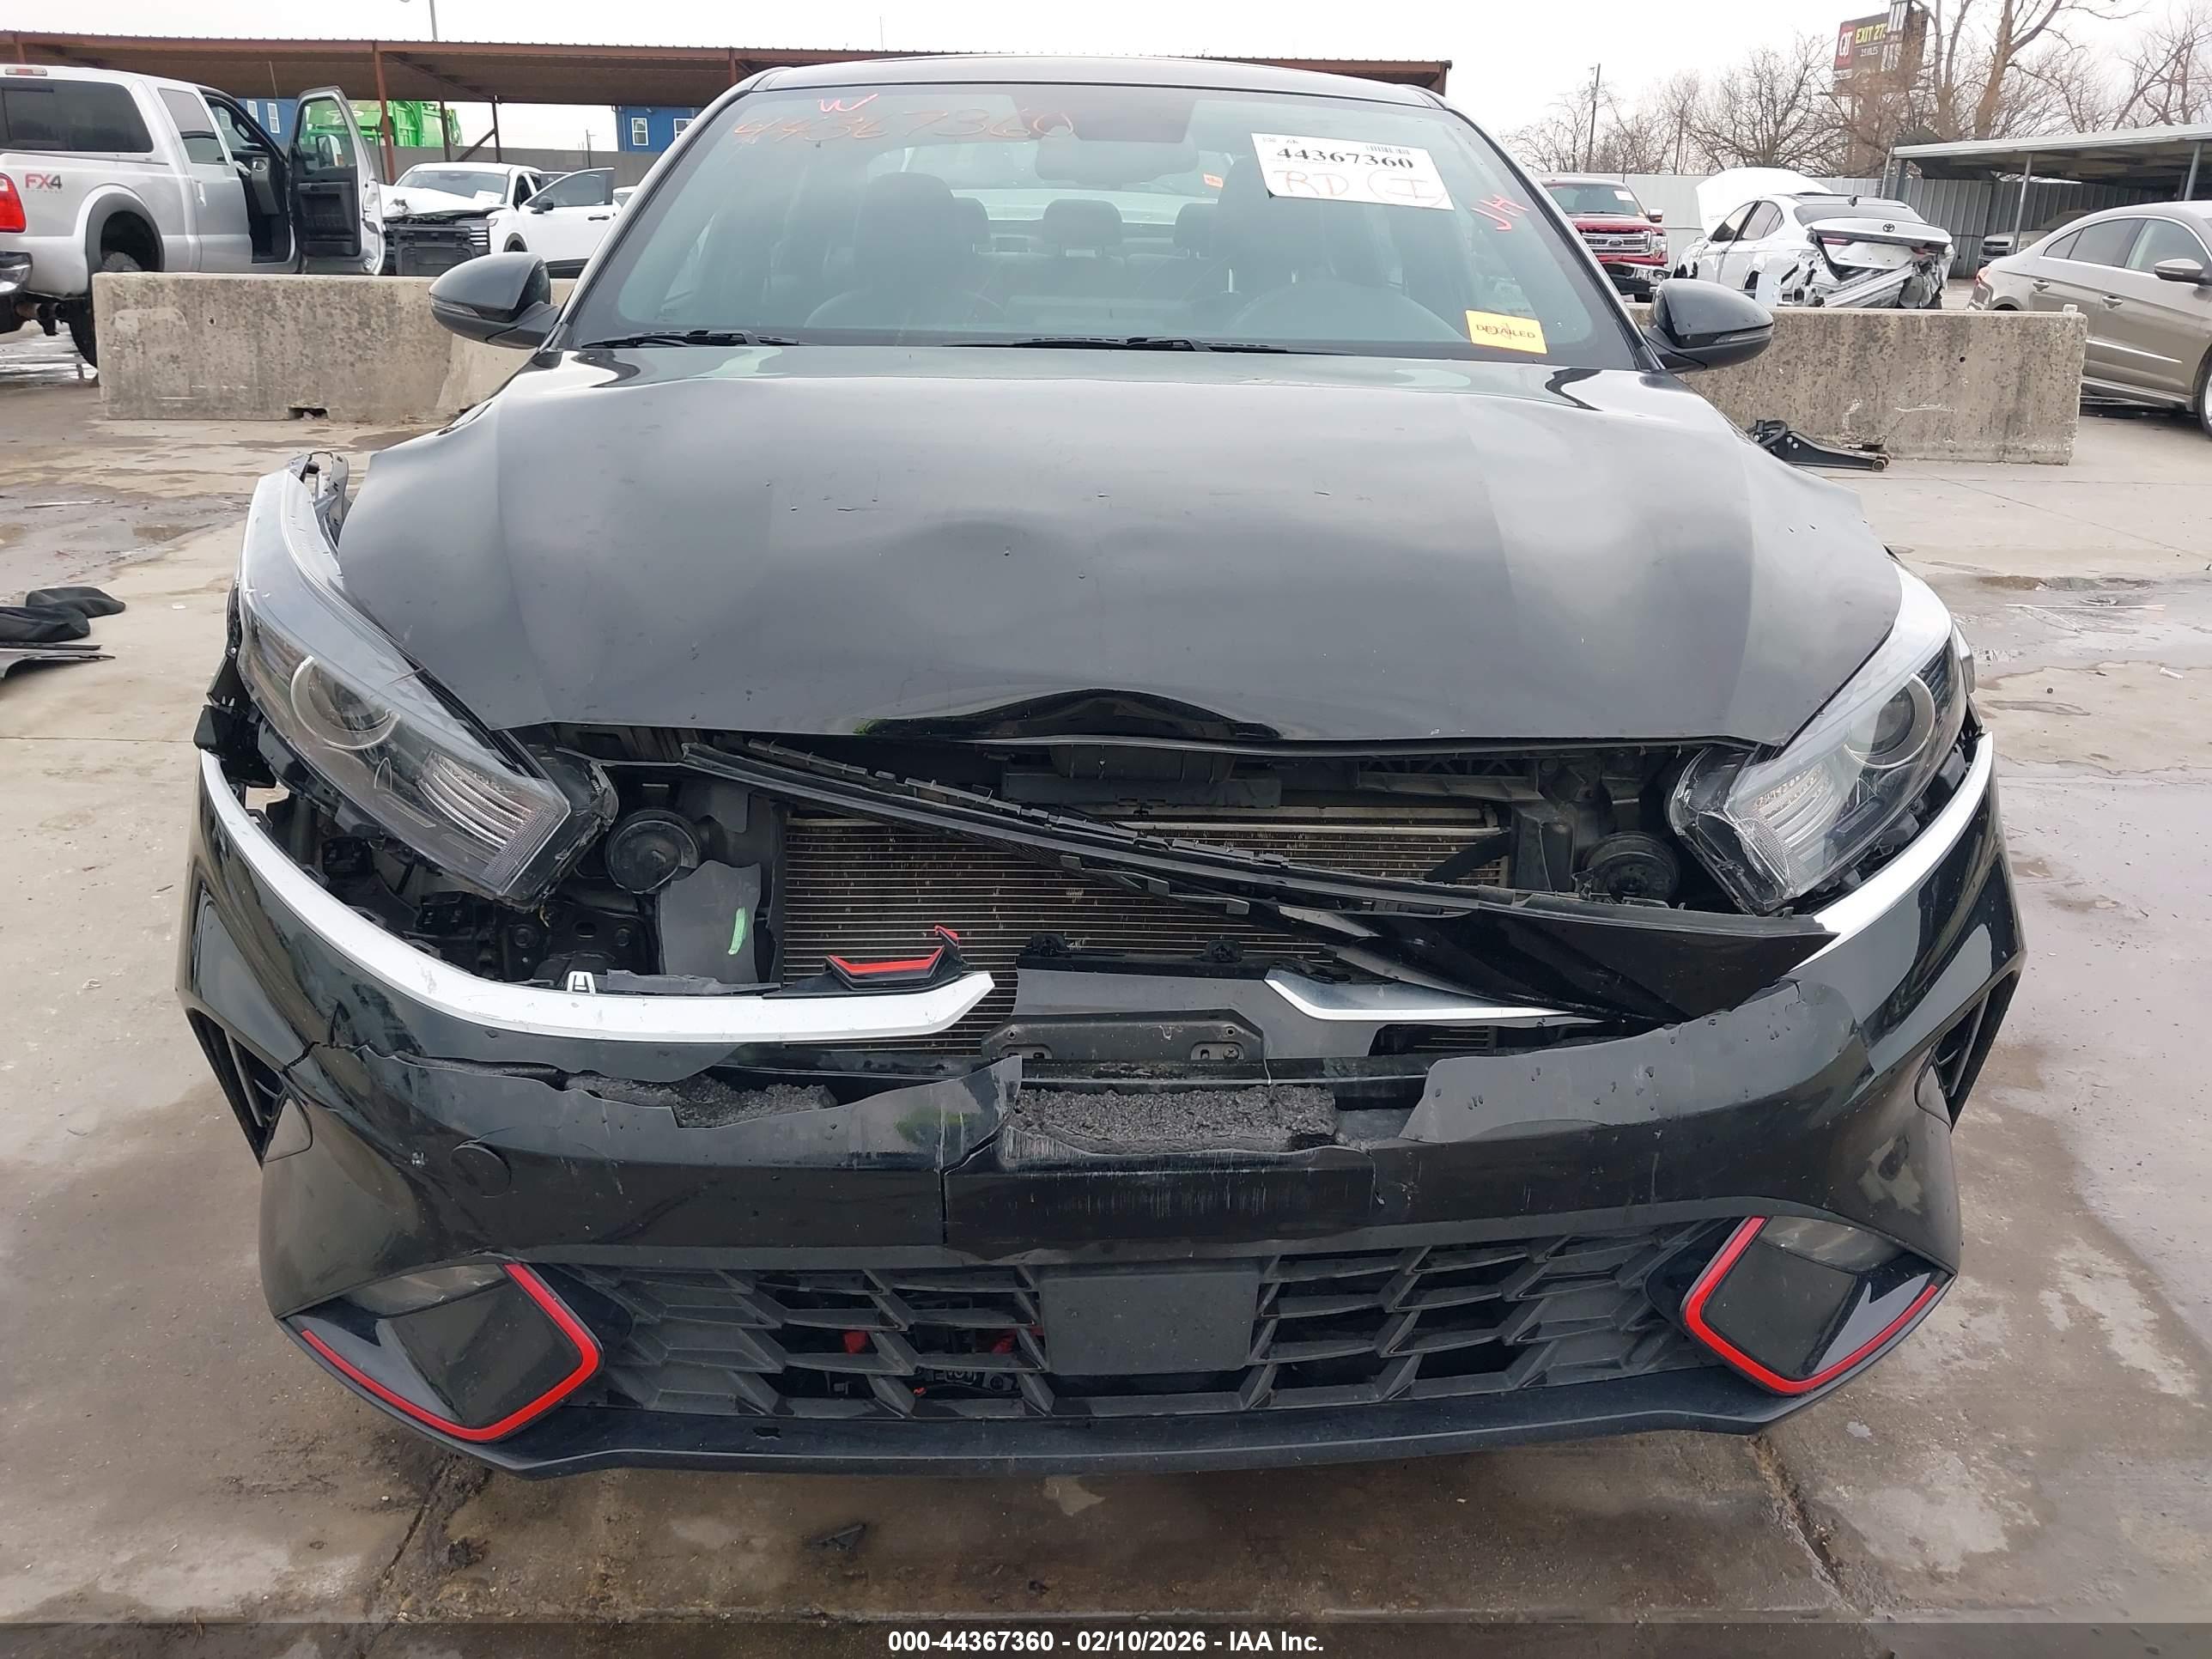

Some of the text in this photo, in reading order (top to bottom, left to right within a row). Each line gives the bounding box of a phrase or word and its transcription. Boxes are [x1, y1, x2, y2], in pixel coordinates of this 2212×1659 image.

[1839, 31, 1853, 58] QT
[1855, 25, 1874, 45] EXIT
[1277, 148, 1414, 169] 44367360
[25, 173, 63, 189] FX4
